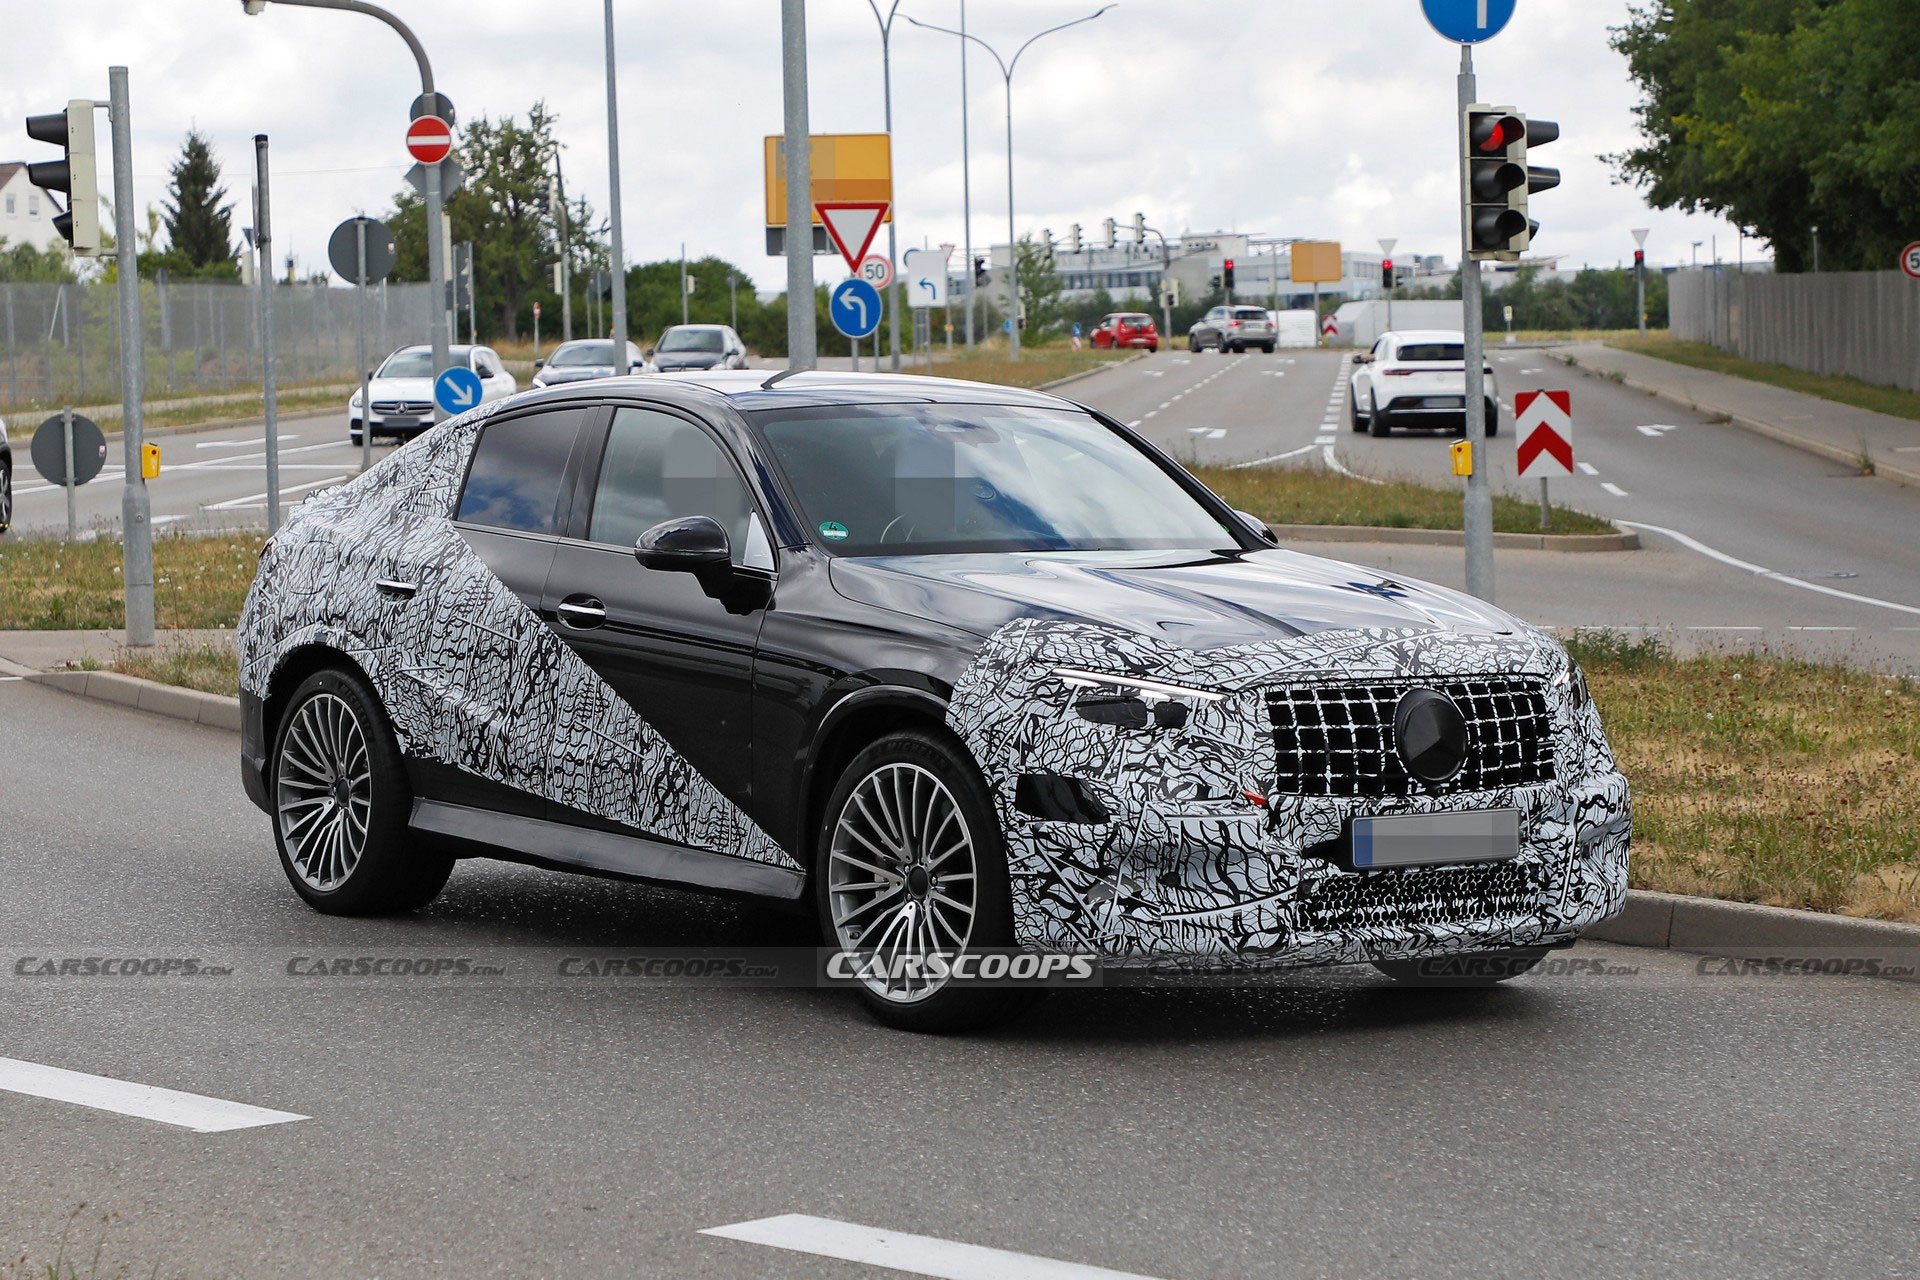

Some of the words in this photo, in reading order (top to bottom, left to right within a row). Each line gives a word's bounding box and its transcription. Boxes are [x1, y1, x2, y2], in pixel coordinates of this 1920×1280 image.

[1910, 252, 1920, 269] 5
[865, 263, 885, 280] 50
[829, 522, 838, 531] 4
[886, 741, 949, 770] MICHE
